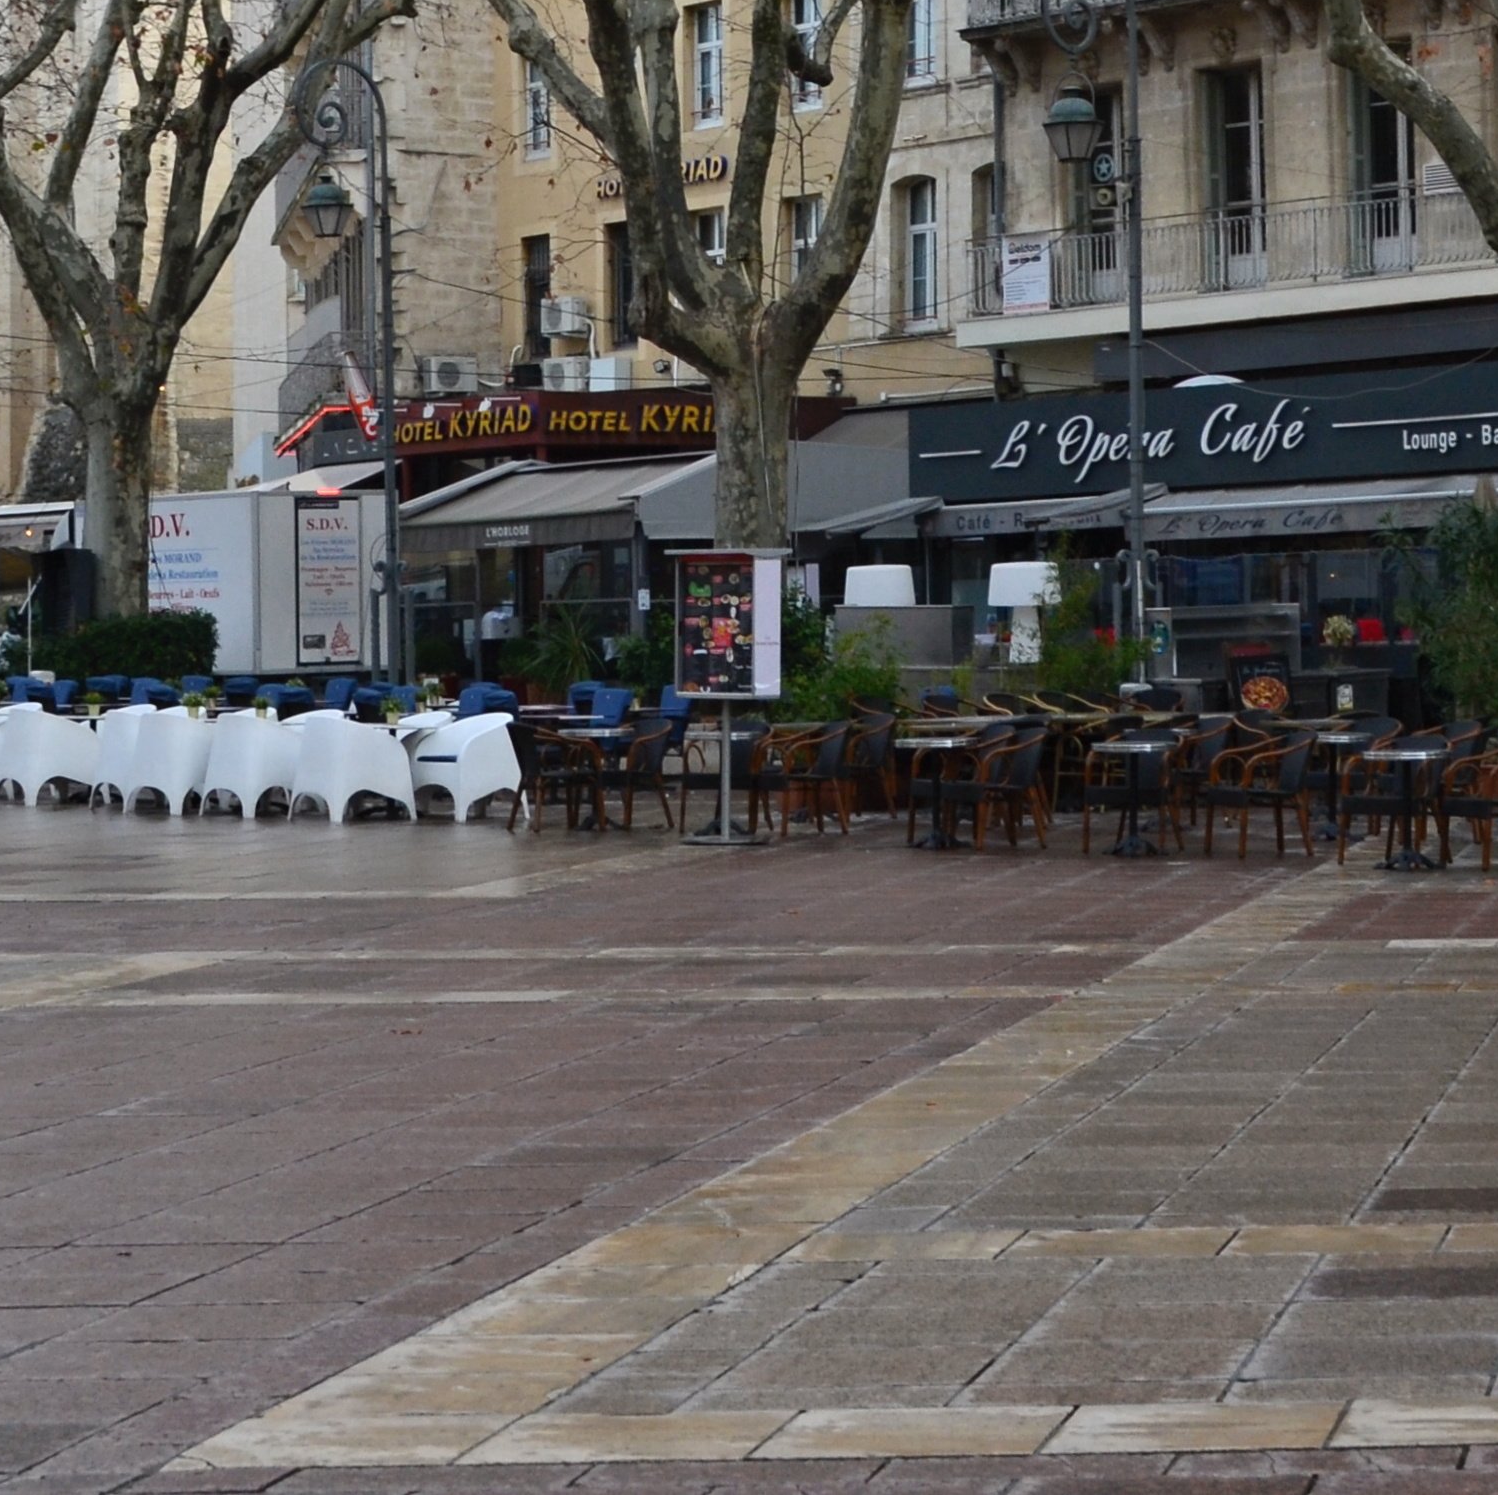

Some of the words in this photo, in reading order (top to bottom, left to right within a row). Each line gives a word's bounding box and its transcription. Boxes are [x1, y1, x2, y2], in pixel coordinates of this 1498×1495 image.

[681, 155, 726, 185] RIAD
[394, 420, 443, 443] HOTEL
[449, 405, 531, 438] KYRIAD
[548, 411, 631, 431] HOTEL
[640, 404, 716, 432] KYRI
[1200, 399, 1311, 463] Café
[1403, 429, 1457, 453] Lounge
[150, 513, 190, 538] D.V.
[306, 517, 348, 531] S.D.V.
